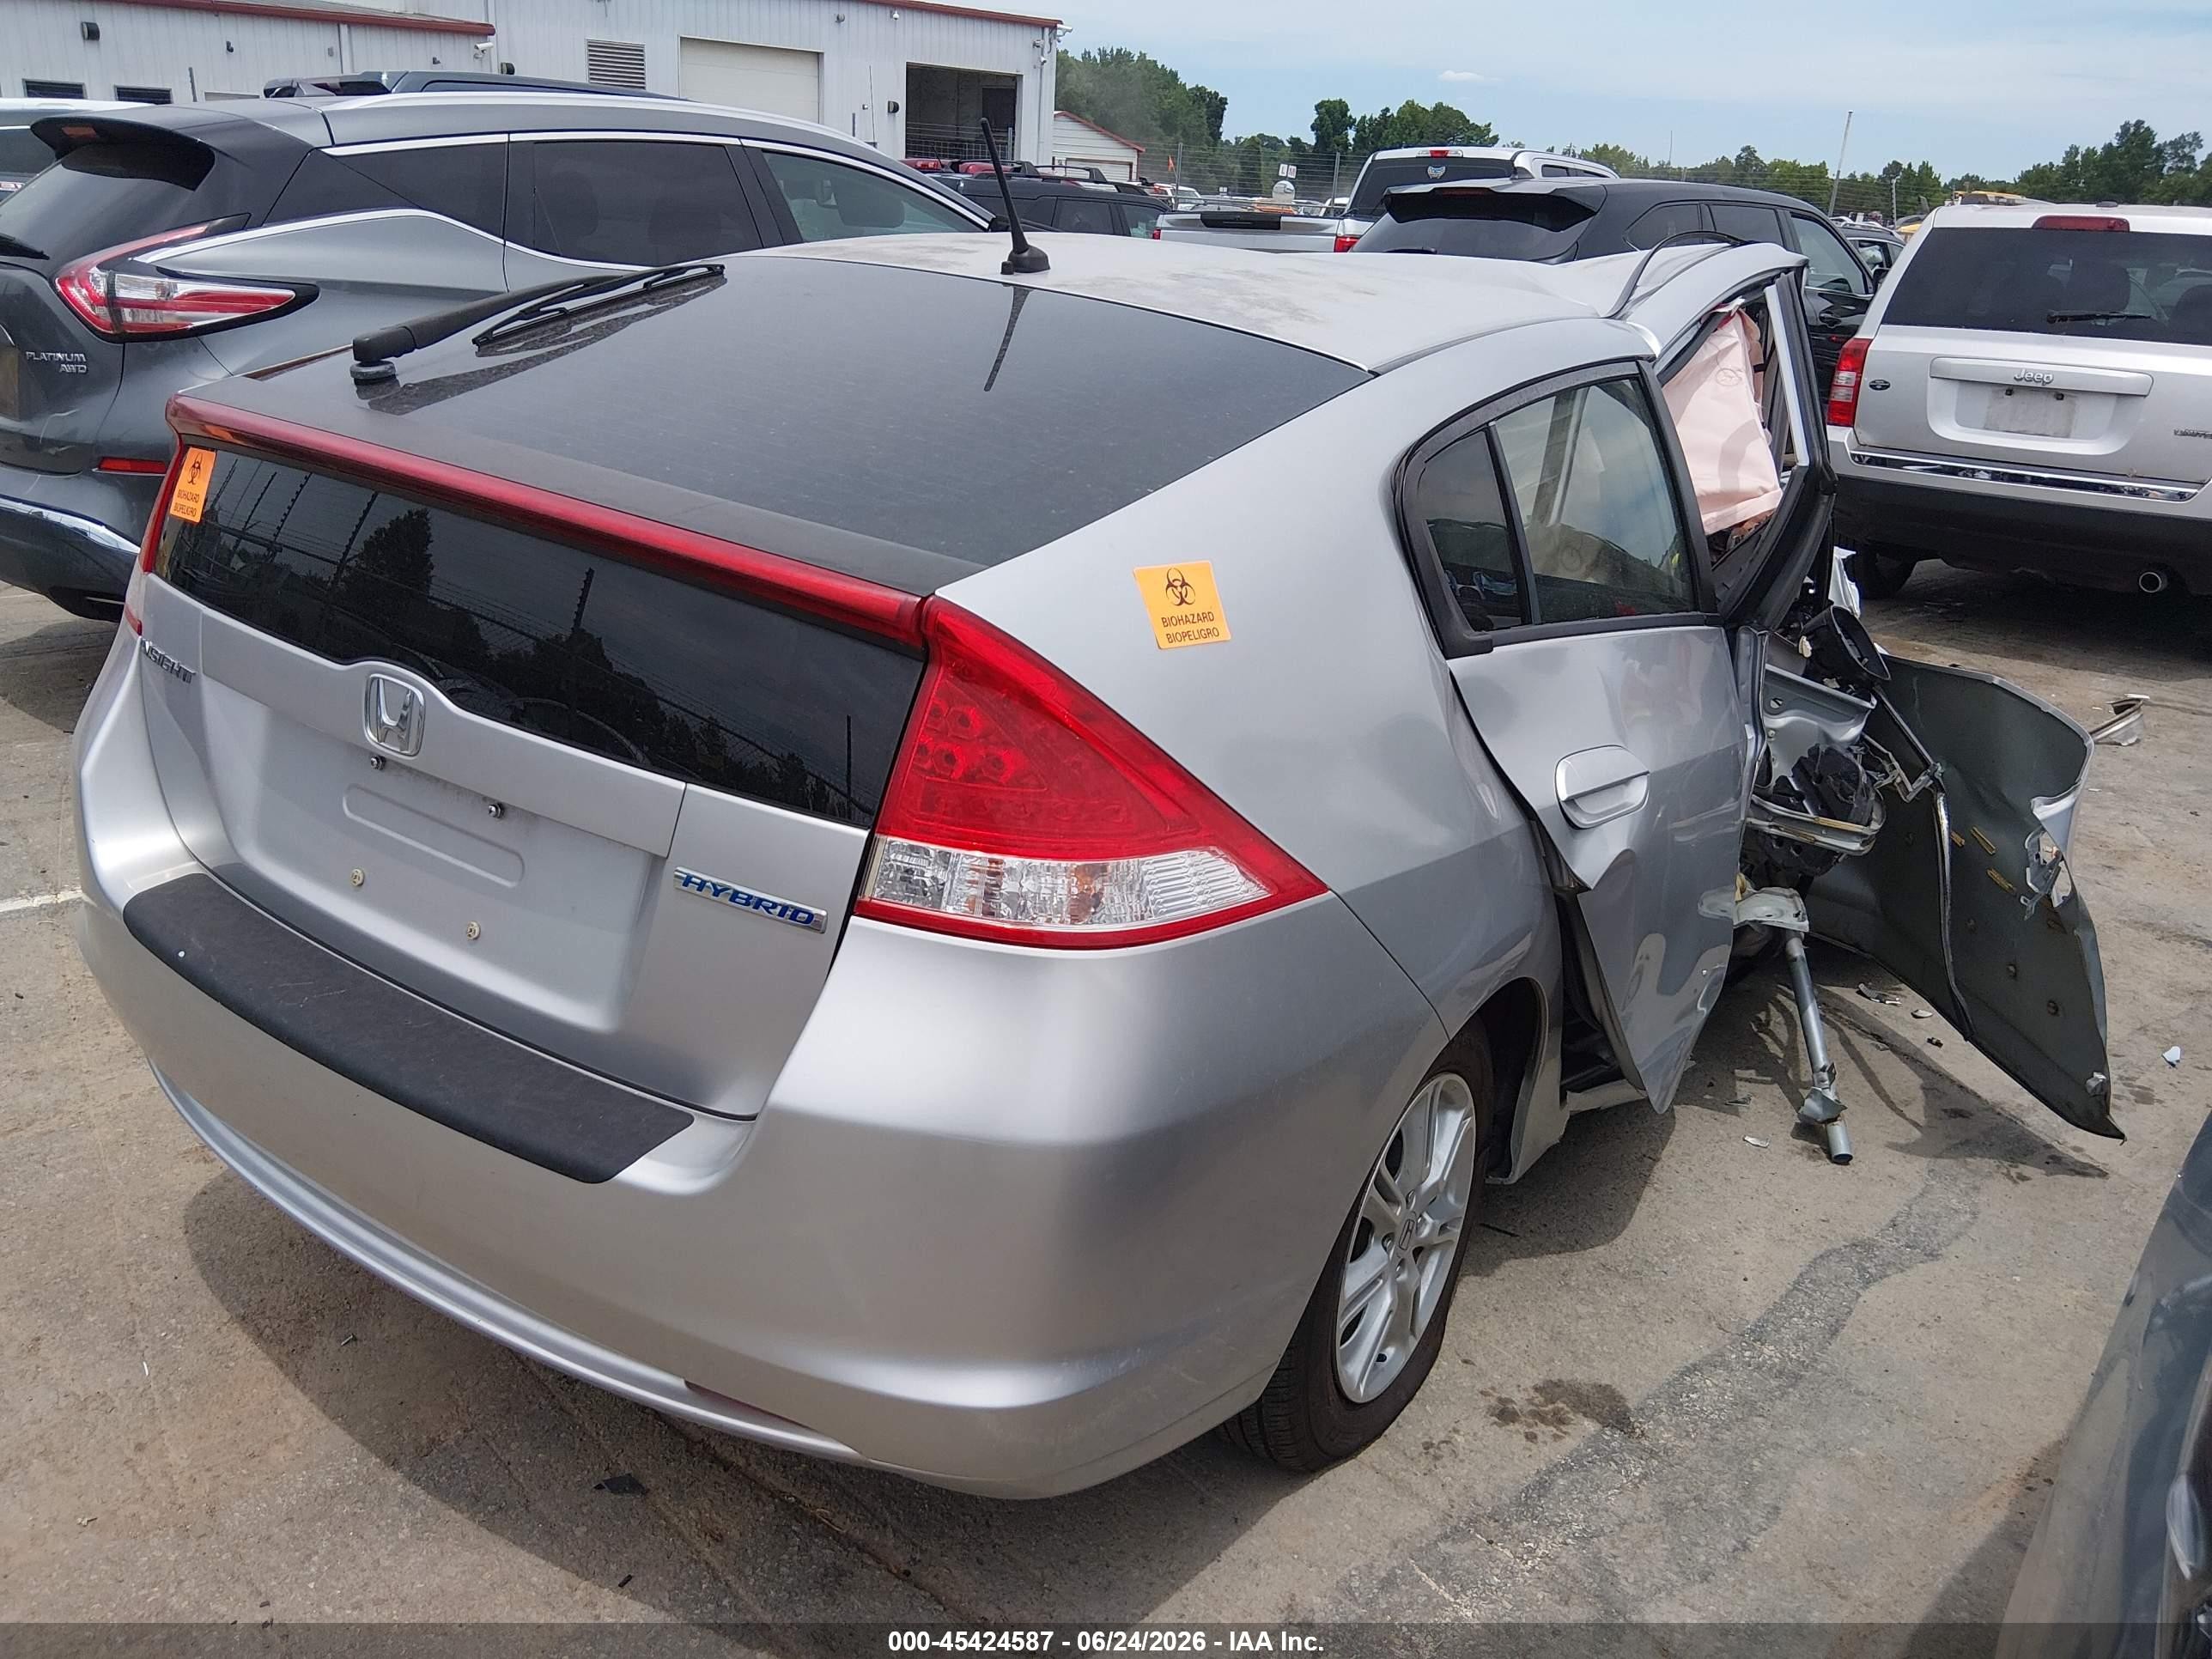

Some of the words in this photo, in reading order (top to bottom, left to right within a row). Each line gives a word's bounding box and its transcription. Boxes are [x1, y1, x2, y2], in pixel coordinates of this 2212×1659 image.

[26, 351, 87, 362] PLATINUM
[59, 364, 88, 374] AWD
[2014, 369, 2054, 386] Jeep
[177, 489, 200, 503] BIOHAZARD
[173, 502, 198, 517] BIOPELIGRO
[1161, 611, 1215, 628] BIOHAZARD
[1166, 627, 1219, 644] BIOPELIGRO
[682, 872, 815, 925] HYBRID
